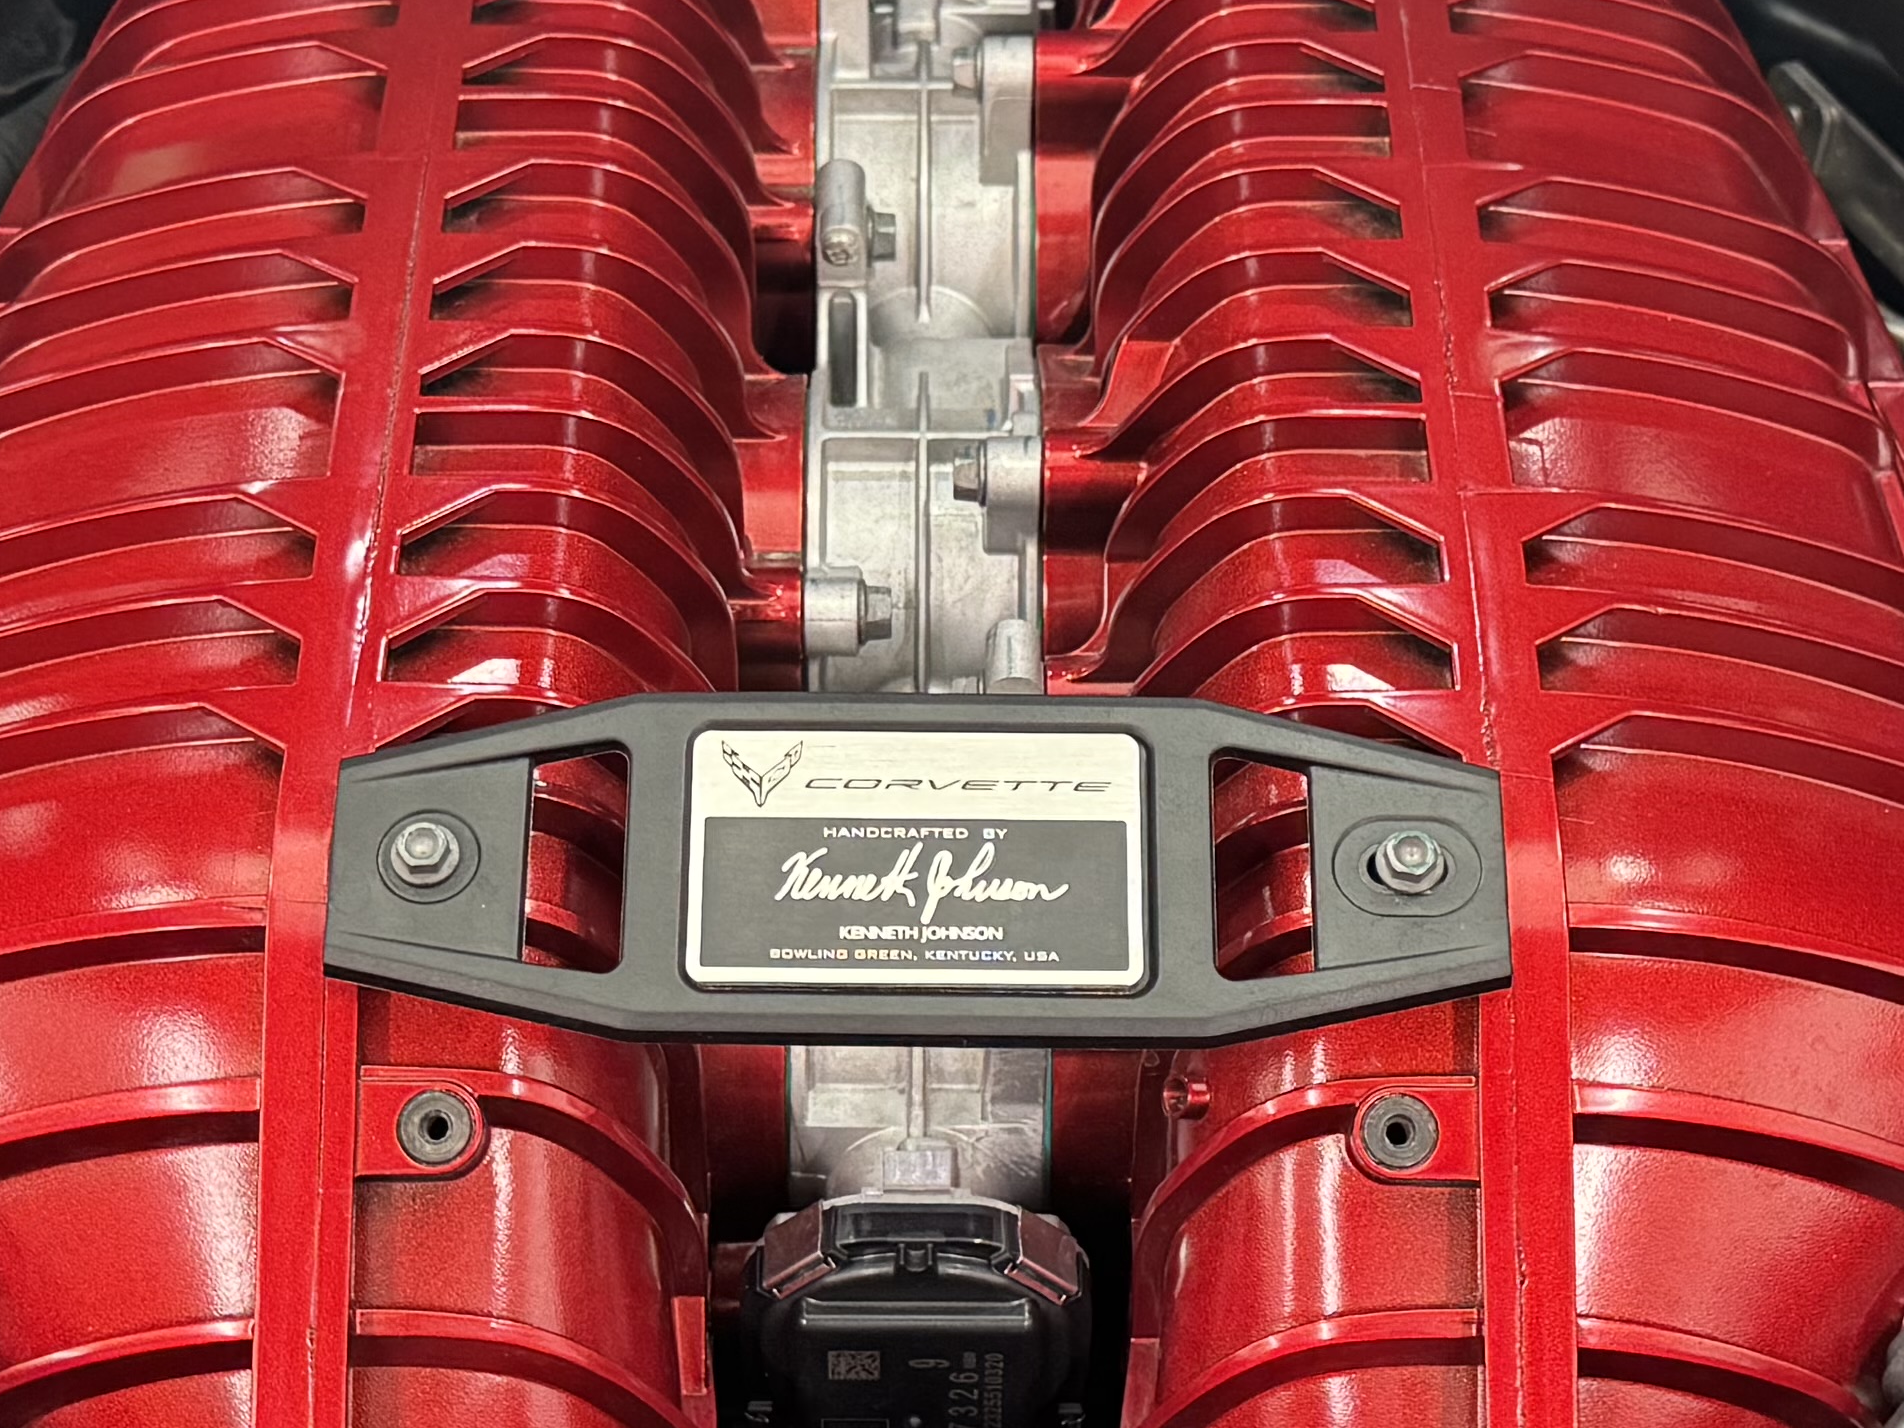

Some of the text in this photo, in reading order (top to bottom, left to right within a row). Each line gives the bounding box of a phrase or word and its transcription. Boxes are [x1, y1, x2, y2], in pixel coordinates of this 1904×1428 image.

[804, 777, 1112, 792] CORVETTE
[823, 827, 1008, 839] HANDCRAFTED BY
[774, 841, 1070, 925] Kenneth Johnson
[839, 926, 1004, 943] KENNETH JOHNSON
[769, 948, 1060, 962] BOWLING GREEN, KENTUCKY, USA
